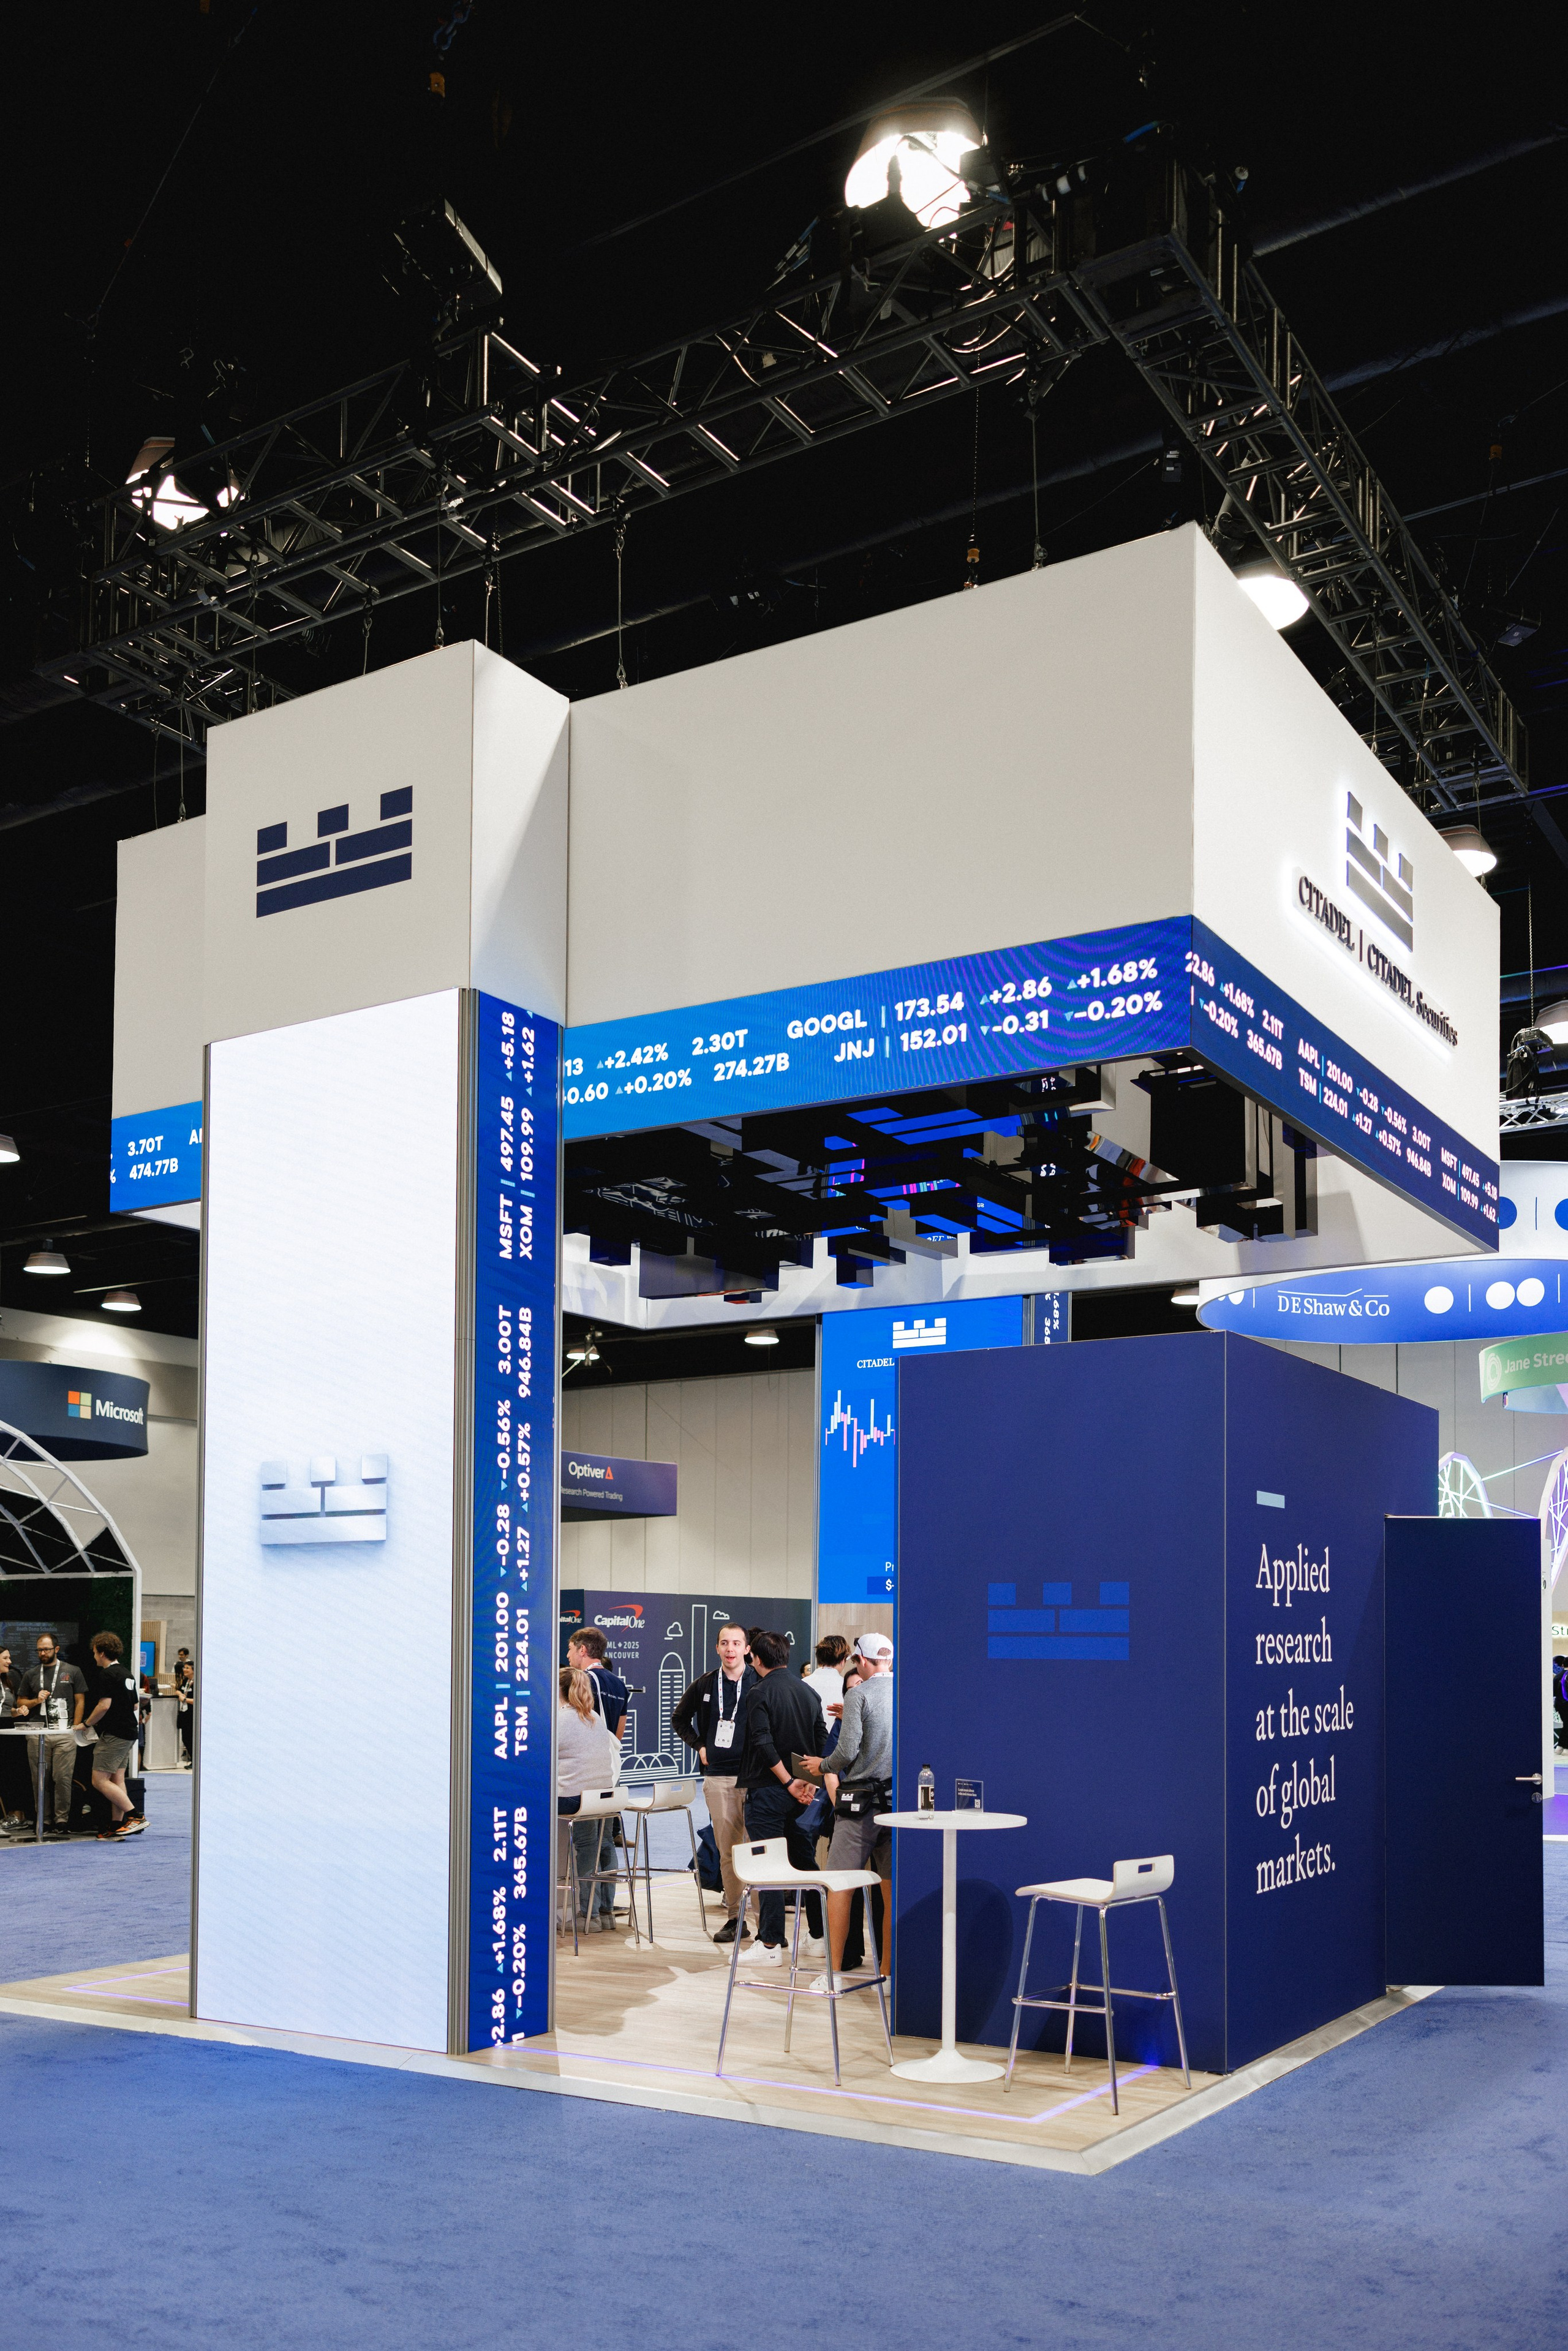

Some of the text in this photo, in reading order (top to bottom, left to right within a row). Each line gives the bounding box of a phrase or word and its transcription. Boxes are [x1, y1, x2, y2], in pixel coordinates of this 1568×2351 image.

[1298, 876, 1458, 1046] CITADEL CITADEL Securities
[501, 1011, 515, 1070] +5.18
[564, 958, 1158, 1077] 13 +2.42% 2.30T GOOGL 173.54 +2.86 +1.68%
[564, 991, 1163, 1104] 0.60 +0.20% 274.27B JNJ 152.01 -0.31 -0.20%
[521, 1027, 535, 1083] +1.62
[1185, 951, 1498, 1201] 2.86 +1.68% 2.11T AAPL 201.00 -0.28 -0.56% 3.00T MSFT 497.45 +5.18
[500, 1096, 514, 1172] 497.45
[1203, 1000, 1239, 1039] -0.20%
[1246, 1029, 1283, 1071] 365.67B
[1298, 1067, 1317, 1096] TSM
[1323, 1086, 1348, 1119] 224.01
[1355, 1112, 1373, 1135] +1.27
[1378, 1130, 1402, 1157] +0.57%
[1406, 1147, 1432, 1177] 946.84B
[1442, 1172, 1457, 1195] XOM
[1460, 1186, 1479, 1210] 109.99
[1483, 1204, 1496, 1223] +1.62
[127, 1135, 164, 1157] 3.70T
[129, 1157, 179, 1180] 474.77B
[520, 1108, 534, 1181] 109.99
[499, 1193, 513, 1259] MSFT
[519, 1205, 533, 1261] XOM
[498, 1305, 511, 1375] 3.00T
[518, 1307, 532, 1398] 946.84B
[856, 1357, 895, 1370] CITADEL
[1504, 1357, 1531, 1373] Jane
[96, 1399, 144, 1425] Microsoft
[497, 1399, 511, 1479] -0.56%
[517, 1422, 531, 1501] +0.57%
[568, 1461, 605, 1479] Optiver
[582, 1489, 605, 1499] Powered
[605, 1491, 623, 1502] Trading
[497, 1504, 510, 1566] -0.28
[516, 1526, 530, 1580] +1.27
[1256, 1543, 1330, 1607] Applied
[495, 1591, 509, 1672] 201.00
[515, 1609, 529, 1681] 224.01
[1256, 1616, 1332, 1665] research
[494, 1697, 508, 1760] AAPL
[514, 1706, 528, 1756] TSM
[1256, 1685, 1354, 1742] at the scale
[1256, 1754, 1336, 1829] of global
[493, 1806, 507, 1862] 2.11T
[513, 1806, 527, 1899] 365.67B
[1256, 1833, 1336, 1894] markets.
[492, 1886, 507, 1964] +1.68%
[512, 1923, 526, 2008] -0.20%
